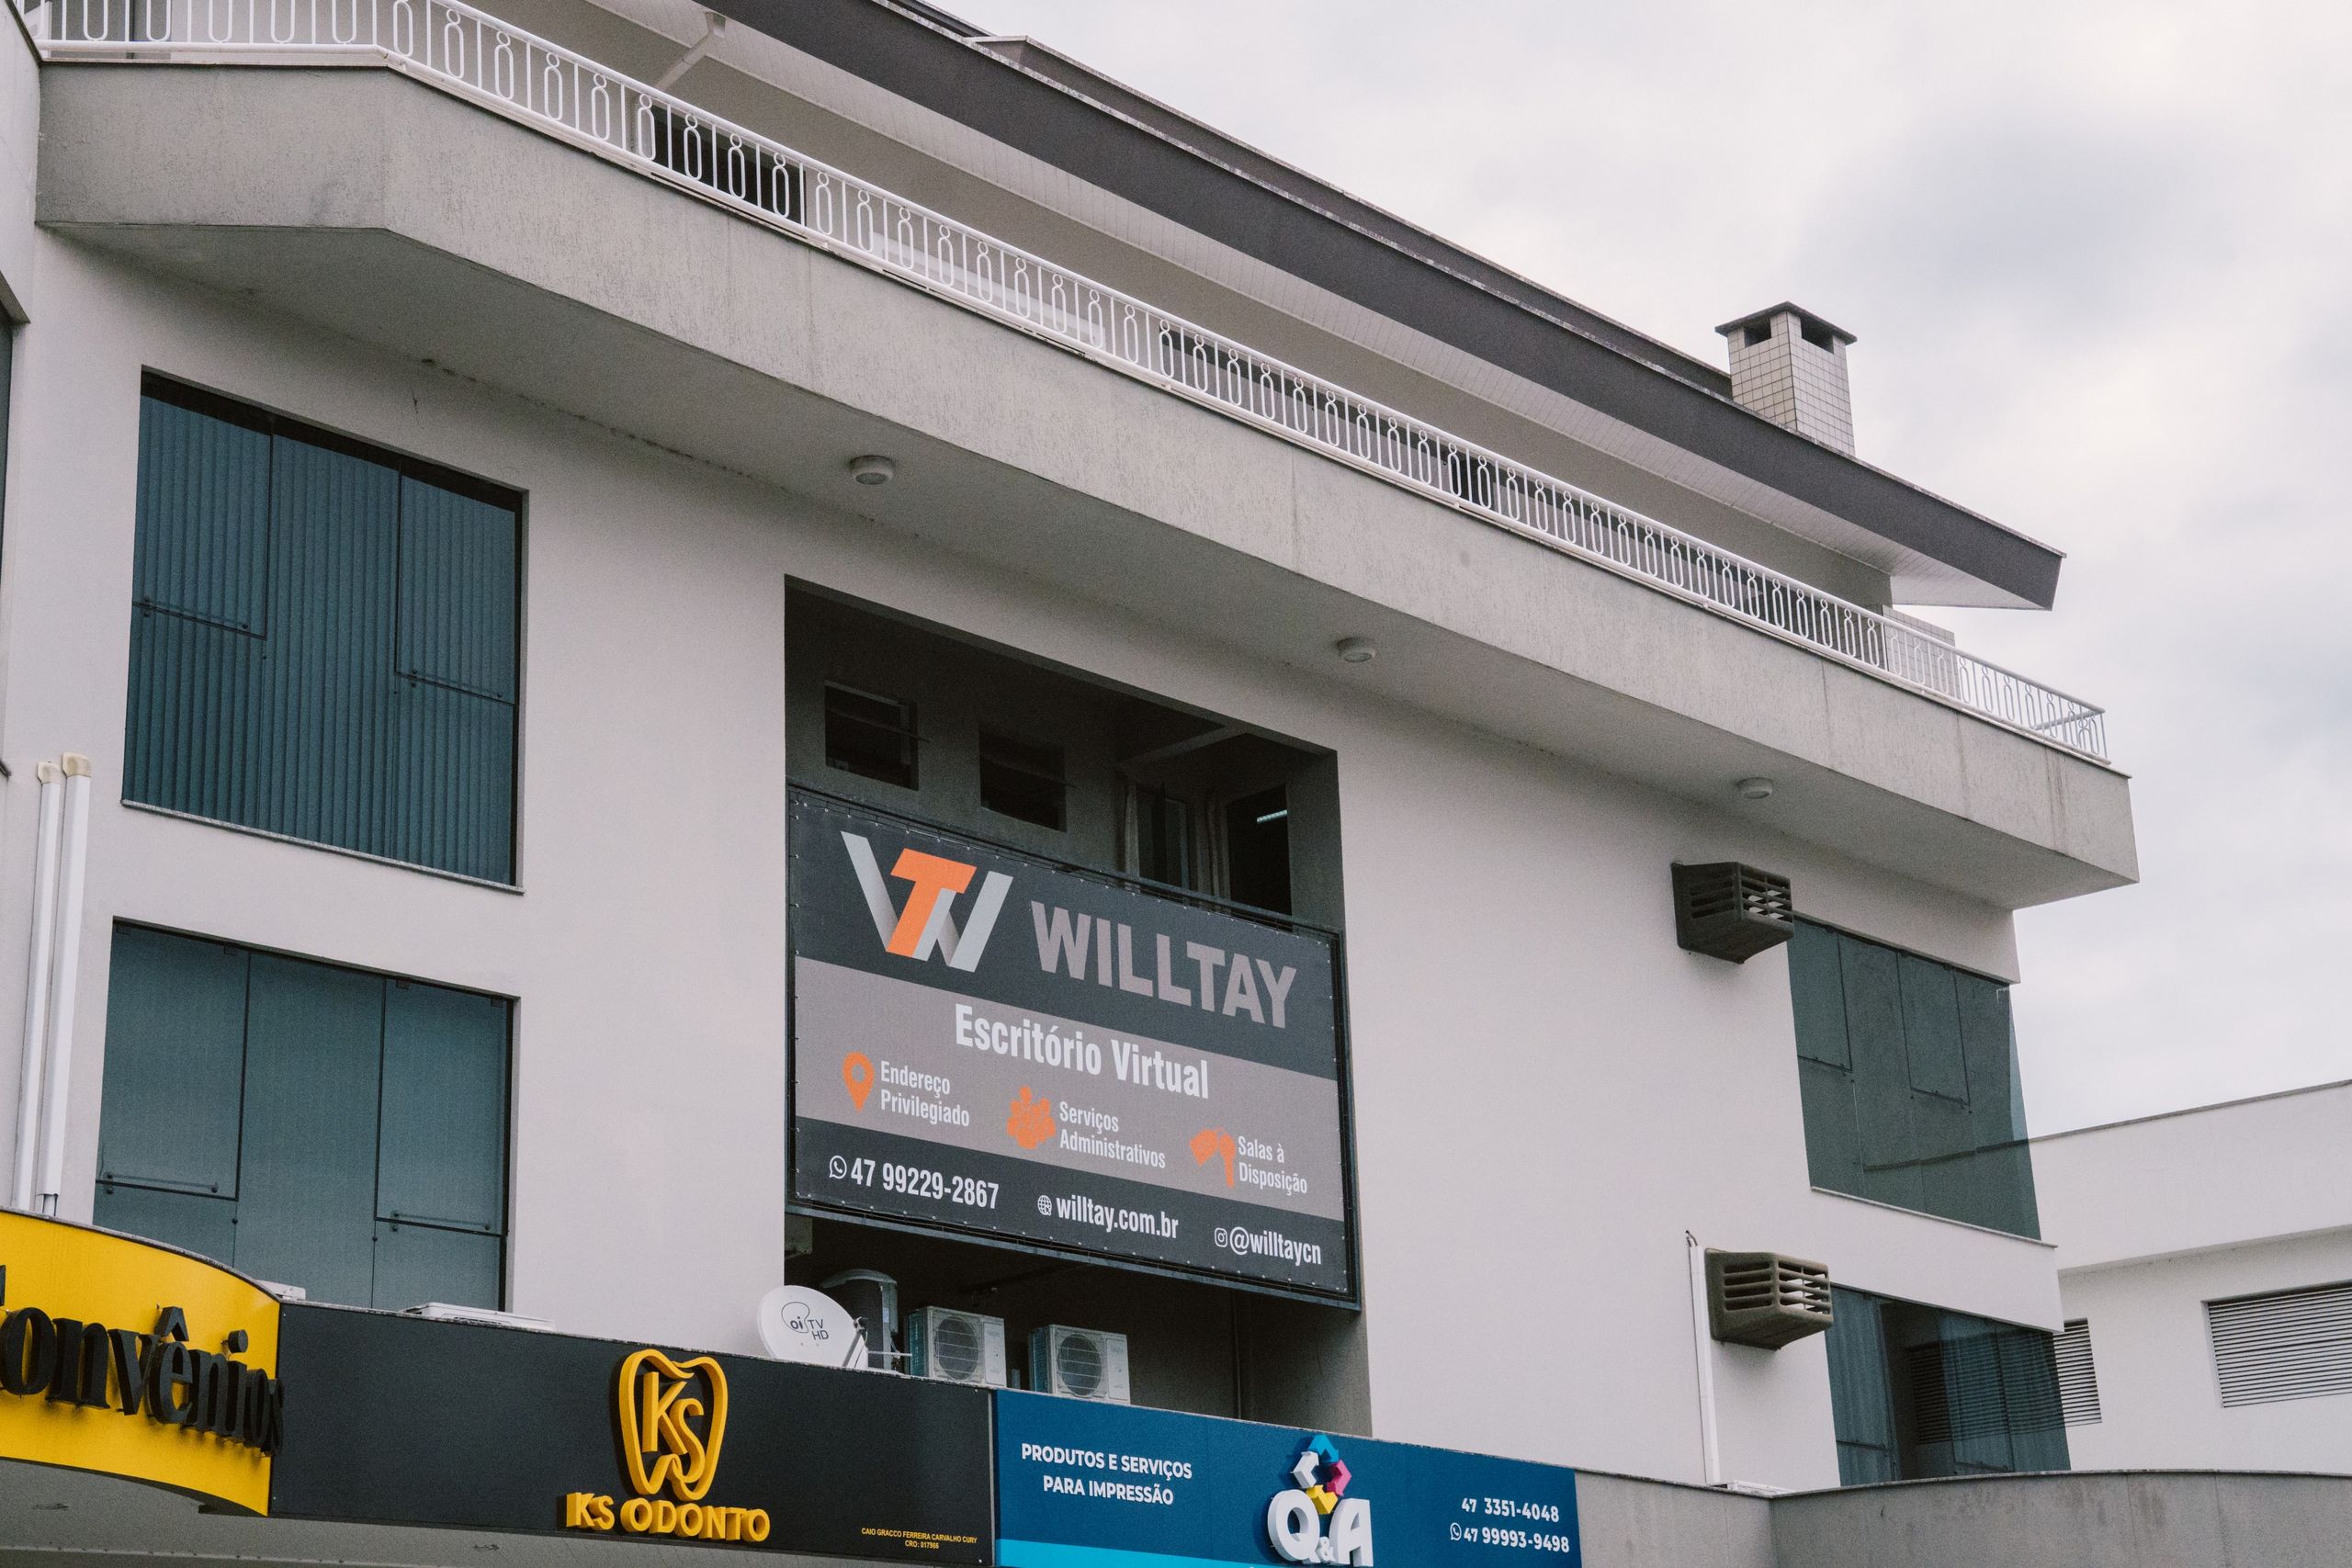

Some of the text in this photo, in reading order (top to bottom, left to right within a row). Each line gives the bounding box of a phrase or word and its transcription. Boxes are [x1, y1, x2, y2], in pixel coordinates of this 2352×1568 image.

[1030, 900, 1297, 1029] WILLTAY
[955, 1003, 1209, 1099] Escritório Virtual
[880, 1060, 951, 1098] Endereço
[880, 1089, 970, 1127] Privilegiado
[1059, 1100, 1119, 1134] Serviços
[1059, 1129, 1166, 1168] Administrativos
[1238, 1135, 1284, 1163] Salas à
[851, 1157, 999, 1209] 47 99229-2867
[1238, 1162, 1308, 1196] Disposição
[1057, 1194, 1179, 1239] willtay.com.br
[1229, 1226, 1321, 1267] @willtaycn
[807, 1318, 823, 1329] TV
[811, 1329, 829, 1340] HD
[0, 1265, 284, 1457] onvênios
[642, 1371, 706, 1483] KS
[1022, 1443, 1193, 1482] PRODUTOS E SERVIÇOS
[1043, 1475, 1174, 1506] PARA IMPRESSÃO
[566, 1492, 771, 1542] KS ODONTO
[1267, 1489, 1374, 1567] Q&A
[1461, 1497, 1560, 1523] 47 3351-4048
[861, 1528, 876, 1536] CAIO
[876, 1529, 902, 1538] GRACCO
[902, 1530, 931, 1540] FERREIRA
[931, 1533, 962, 1542] CARVALHO
[1464, 1527, 1570, 1553] 47 99993-9498
